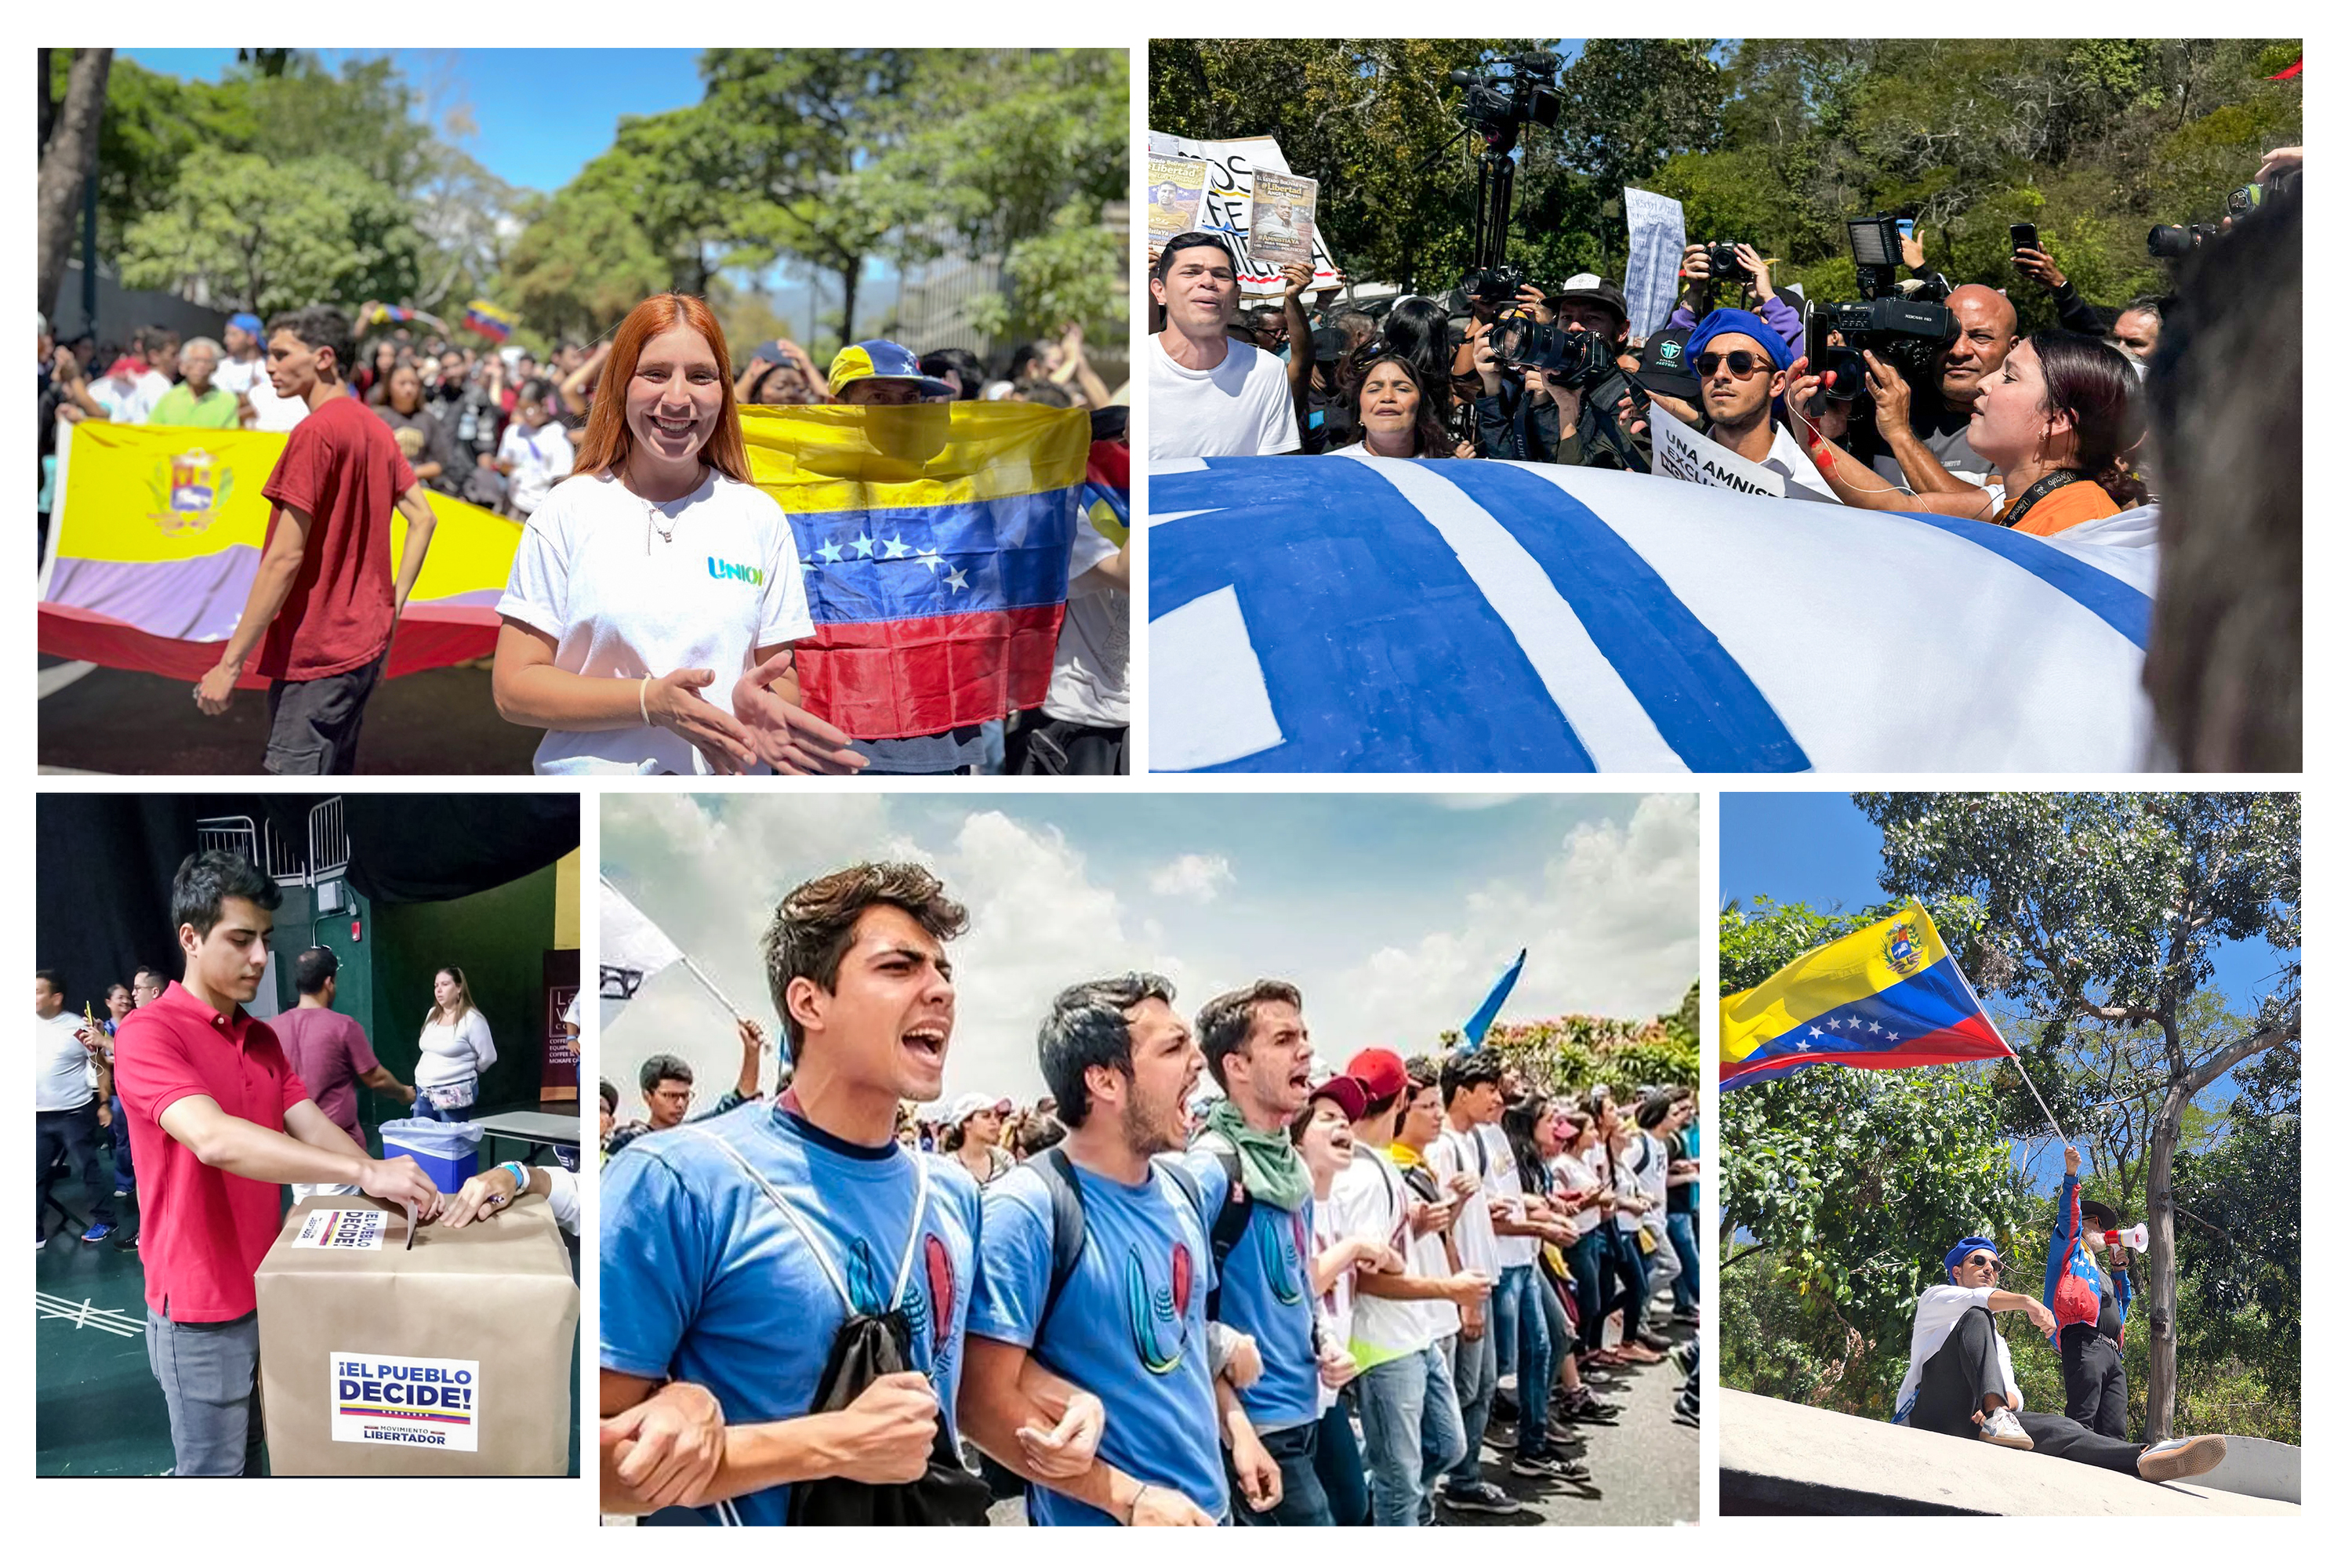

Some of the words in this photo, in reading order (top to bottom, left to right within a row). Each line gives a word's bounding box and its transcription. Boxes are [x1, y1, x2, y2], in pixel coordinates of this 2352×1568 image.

[1261, 182, 1301, 194] #Libertad
[1666, 429, 1699, 465] UNA
[333, 1211, 364, 1247] DECIDE!
[357, 1222, 377, 1247] PUEBLO
[339, 1361, 373, 1378] ¡EL
[378, 1364, 472, 1385] PUEBLO
[339, 1379, 472, 1410] DECIDE!
[364, 1430, 446, 1446] LIBERTADOR
[380, 1425, 429, 1435] MOVIMIENTO
